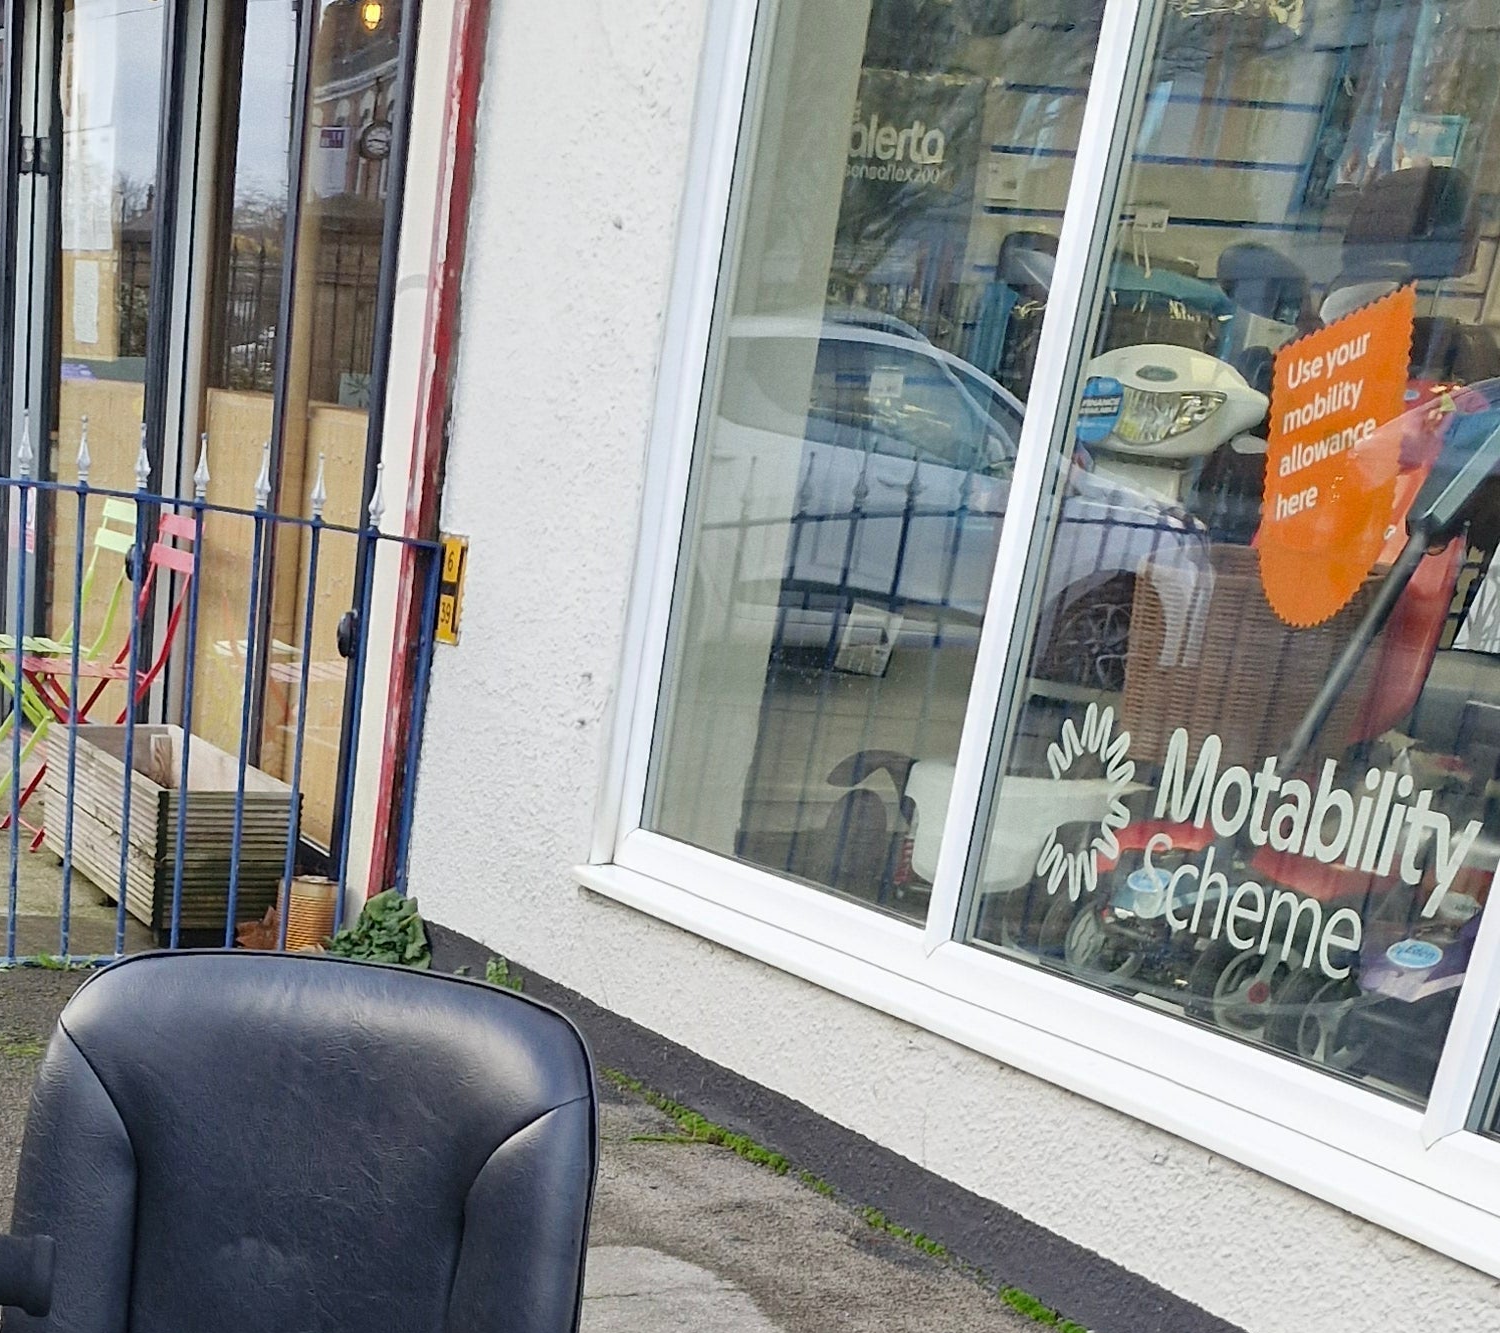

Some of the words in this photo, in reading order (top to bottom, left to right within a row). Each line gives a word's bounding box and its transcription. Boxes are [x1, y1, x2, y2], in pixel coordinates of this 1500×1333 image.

[1287, 357, 1324, 389] Use
[1326, 332, 1371, 379] your
[1282, 379, 1364, 435] mobility
[1279, 417, 1377, 478] allowance
[1275, 486, 1318, 521] here
[447, 551, 455, 573] 6
[440, 602, 451, 625] 39
[1153, 727, 1484, 919] Motability
[1144, 833, 1362, 980] Scheme
